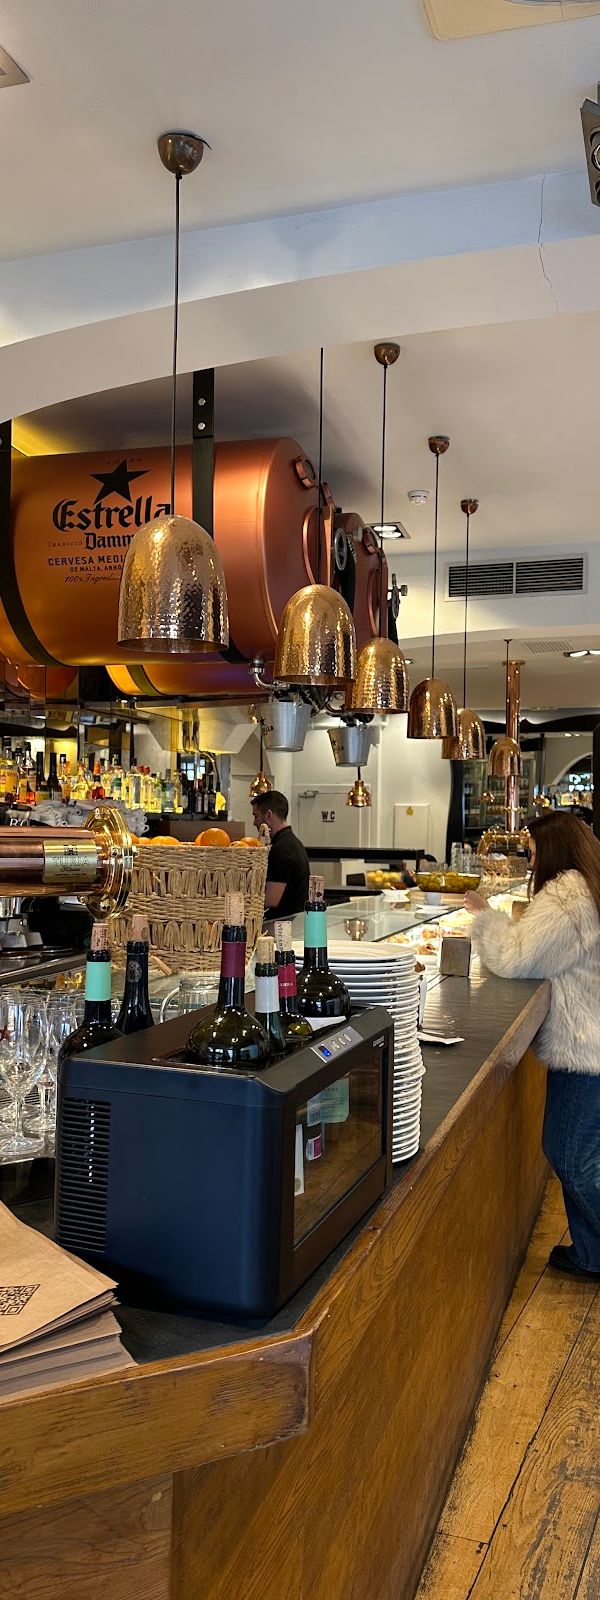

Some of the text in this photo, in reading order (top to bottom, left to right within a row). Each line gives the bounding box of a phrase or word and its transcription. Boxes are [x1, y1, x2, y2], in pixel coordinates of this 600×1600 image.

[52, 495, 171, 532] Estrella
[48, 556, 94, 566] CERVESA
[321, 810, 335, 820] WC
